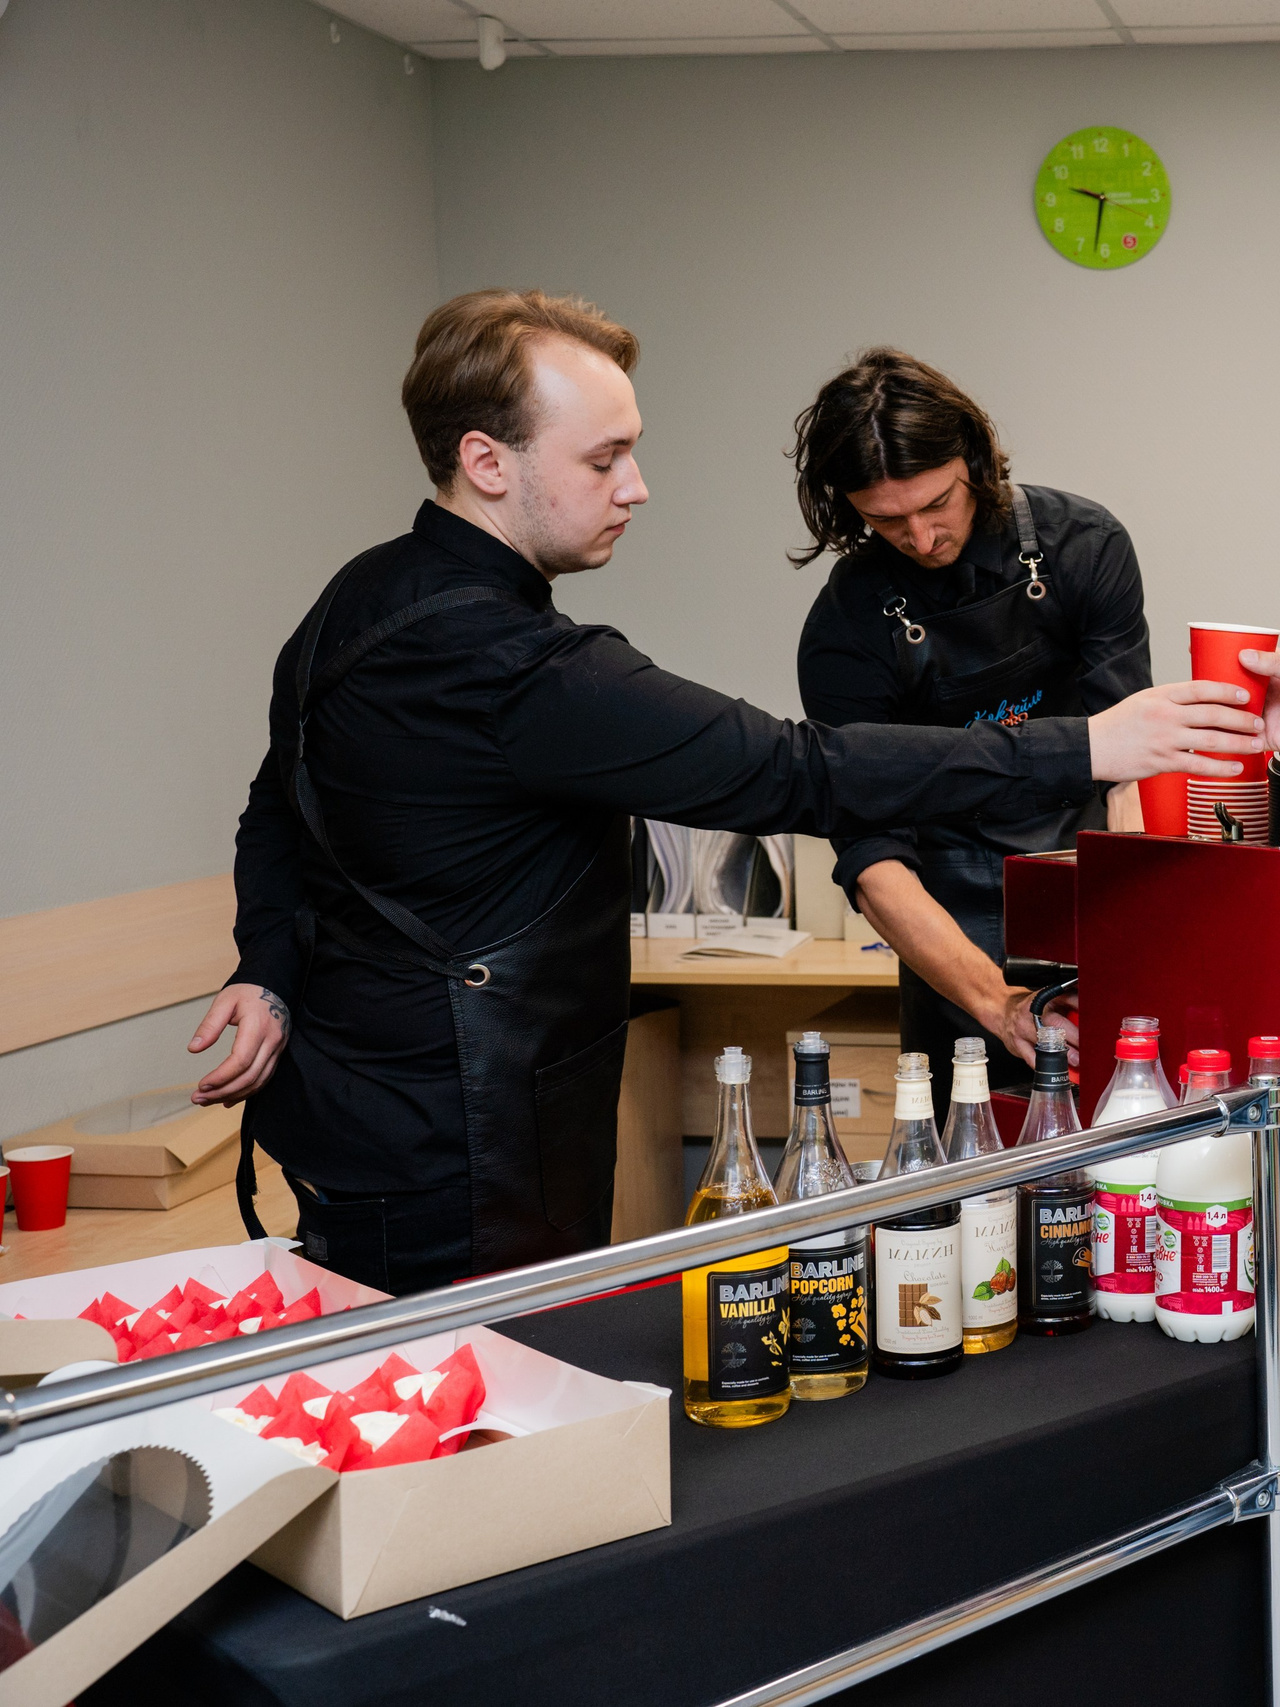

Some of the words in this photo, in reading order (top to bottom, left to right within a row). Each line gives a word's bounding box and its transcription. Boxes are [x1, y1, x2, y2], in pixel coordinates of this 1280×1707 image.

[1071, 144, 1084, 159] 11
[1093, 138, 1109, 153] 12
[1122, 143, 1129, 157] 1
[1054, 165, 1069, 180] 10
[1142, 161, 1152, 177] 2
[1046, 192, 1056, 207] 9
[1150, 188, 1160, 203] 3
[1054, 218, 1064, 232] 8
[1144, 215, 1154, 229] 4
[1076, 237, 1085, 252] 7
[1125, 235, 1135, 248] 5
[1100, 243, 1110, 258] 6
[1207, 1212, 1219, 1220] 1,4
[790, 1252, 864, 1279] BARLINE
[904, 1270, 946, 1282] Chocolate
[719, 1271, 790, 1303] BARLINE
[791, 1274, 854, 1295] POPCORN
[791, 1293, 811, 1305] High
[811, 1291, 835, 1306] quality
[720, 1297, 776, 1319] VANILLA
[742, 1314, 766, 1329] quality
